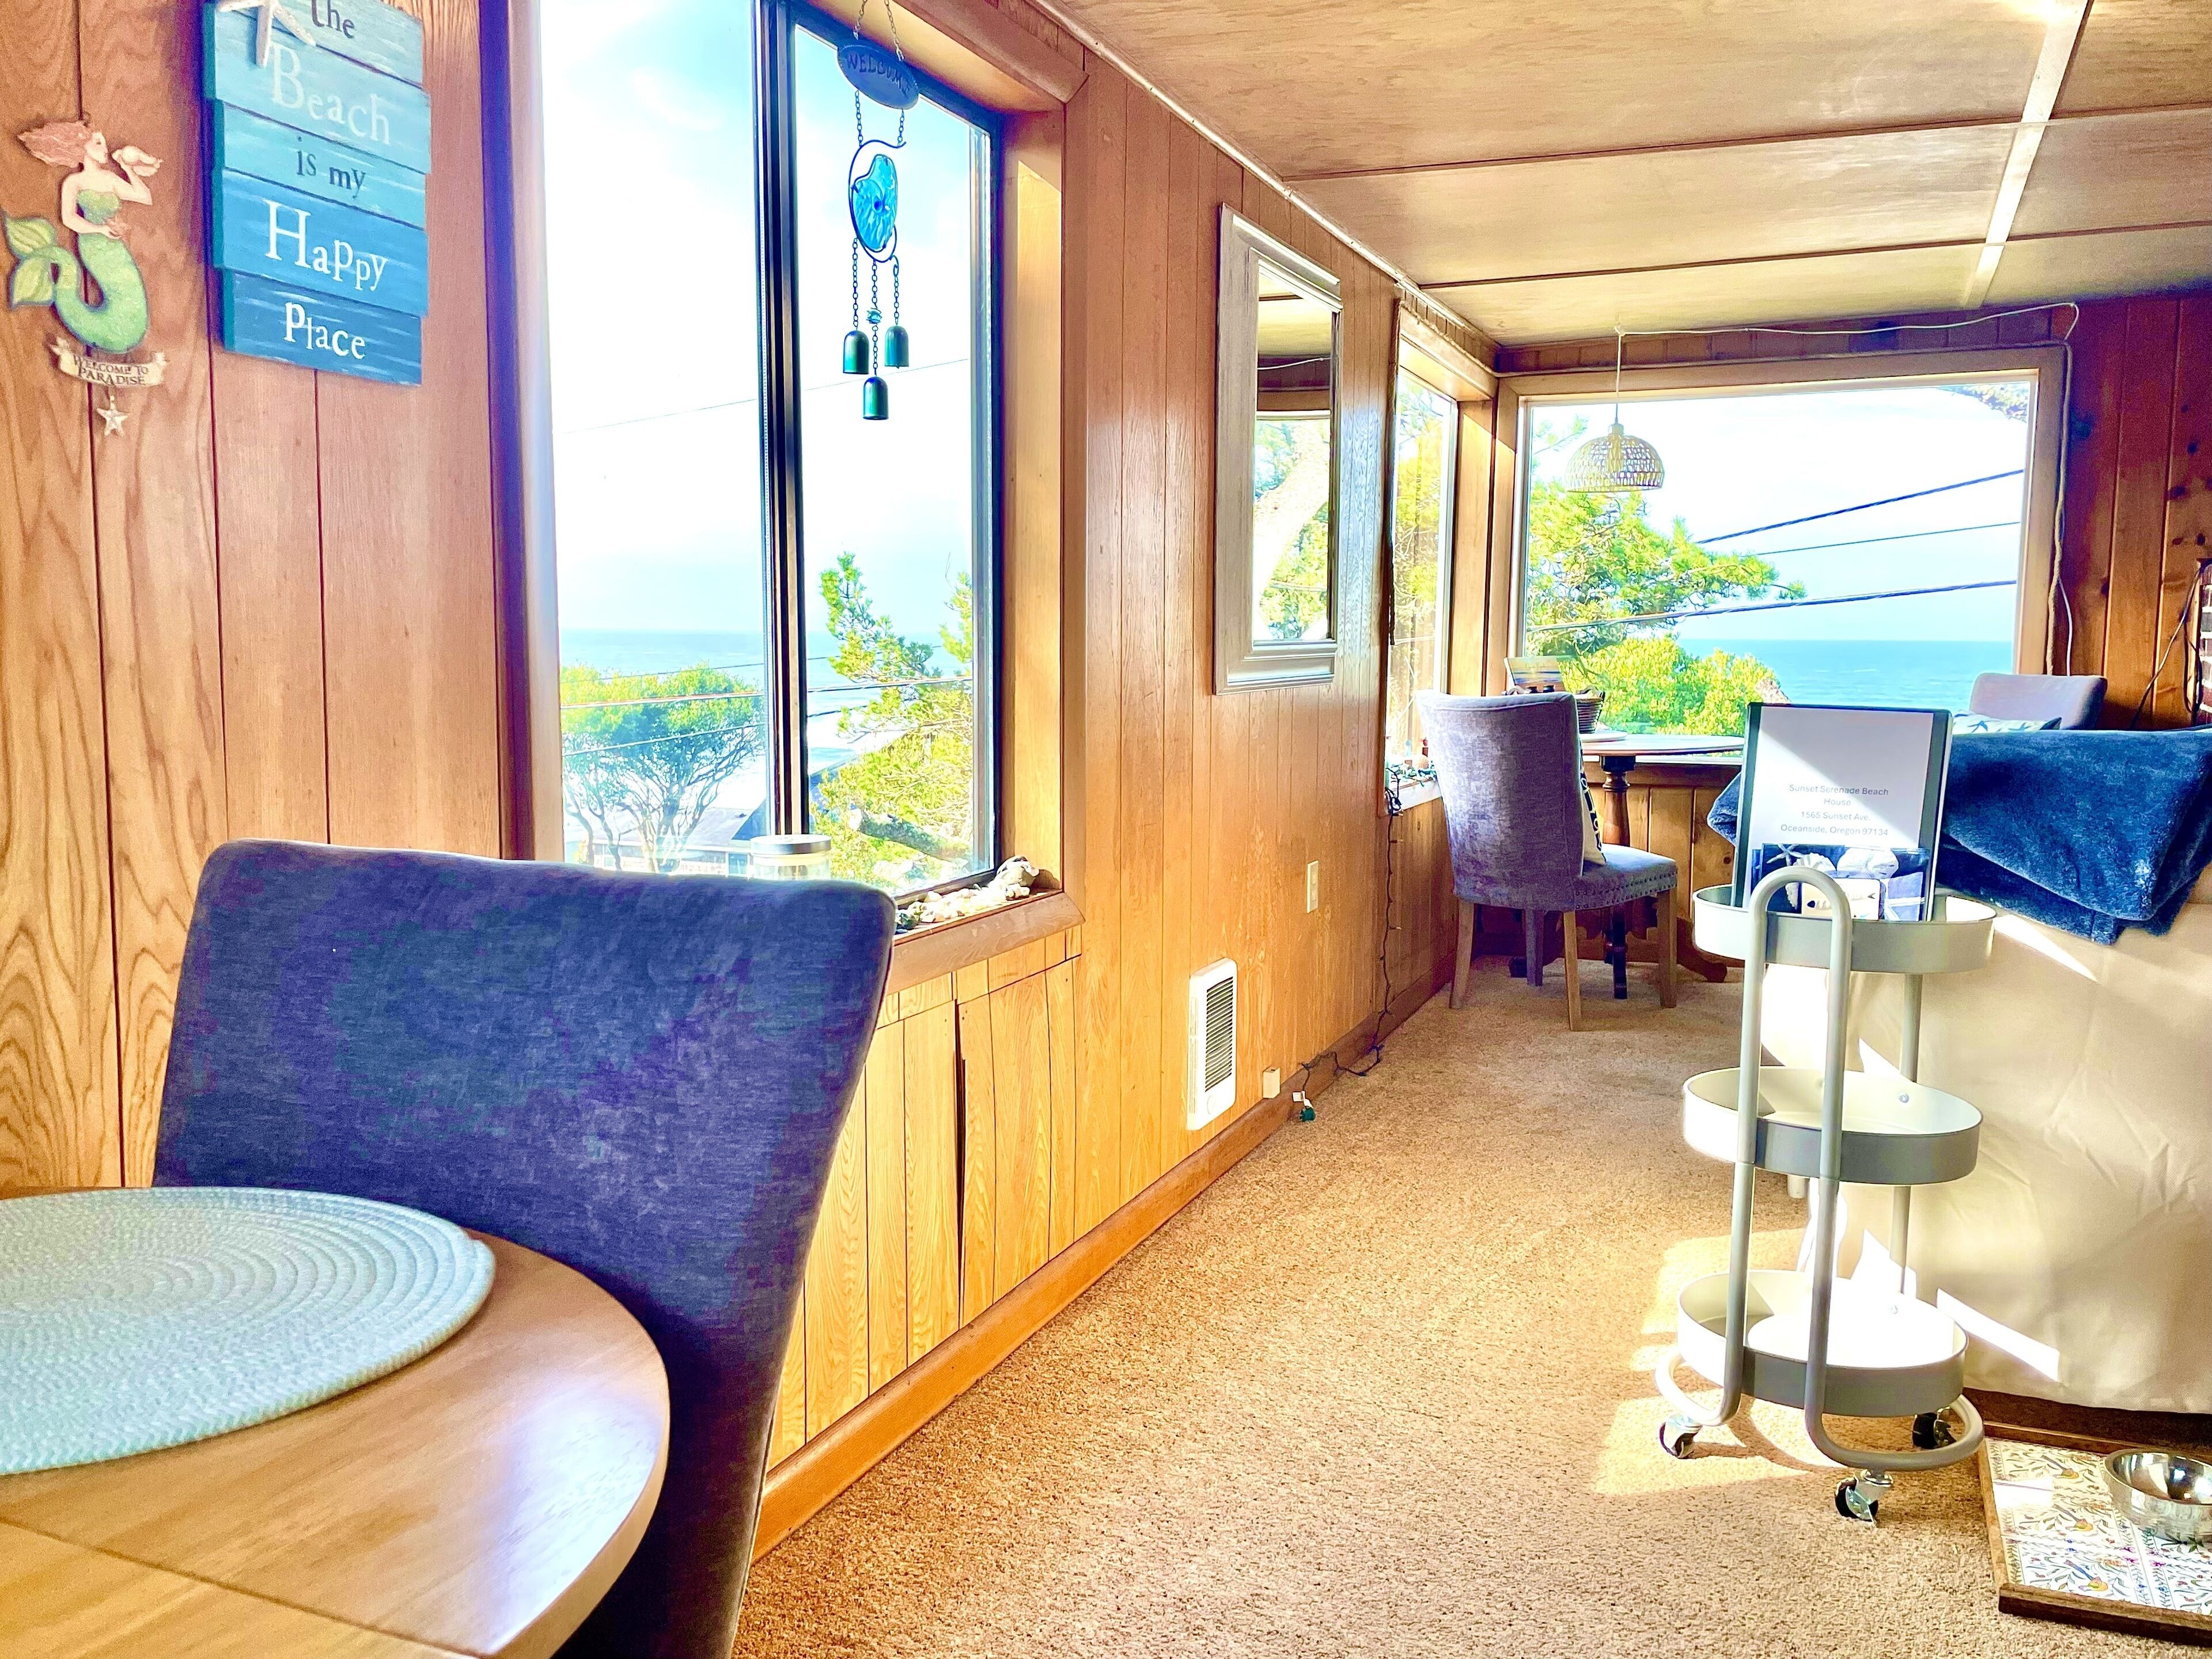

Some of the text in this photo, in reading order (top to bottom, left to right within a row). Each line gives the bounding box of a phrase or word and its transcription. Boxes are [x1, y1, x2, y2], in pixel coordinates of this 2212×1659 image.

[311, 0, 356, 39] the
[270, 43, 391, 146] Beach
[297, 137, 366, 200] is my
[264, 199, 388, 291] Happy
[284, 301, 366, 359] Place
[73, 354, 149, 375] WELCOME TO
[78, 366, 146, 386] PARADISE
[1789, 784, 1889, 796] Sunset Serenade Beach
[1781, 824, 1827, 834] Oceanside,
[1830, 826, 1861, 835] Oregon
[1823, 812, 1852, 820] Sunset
